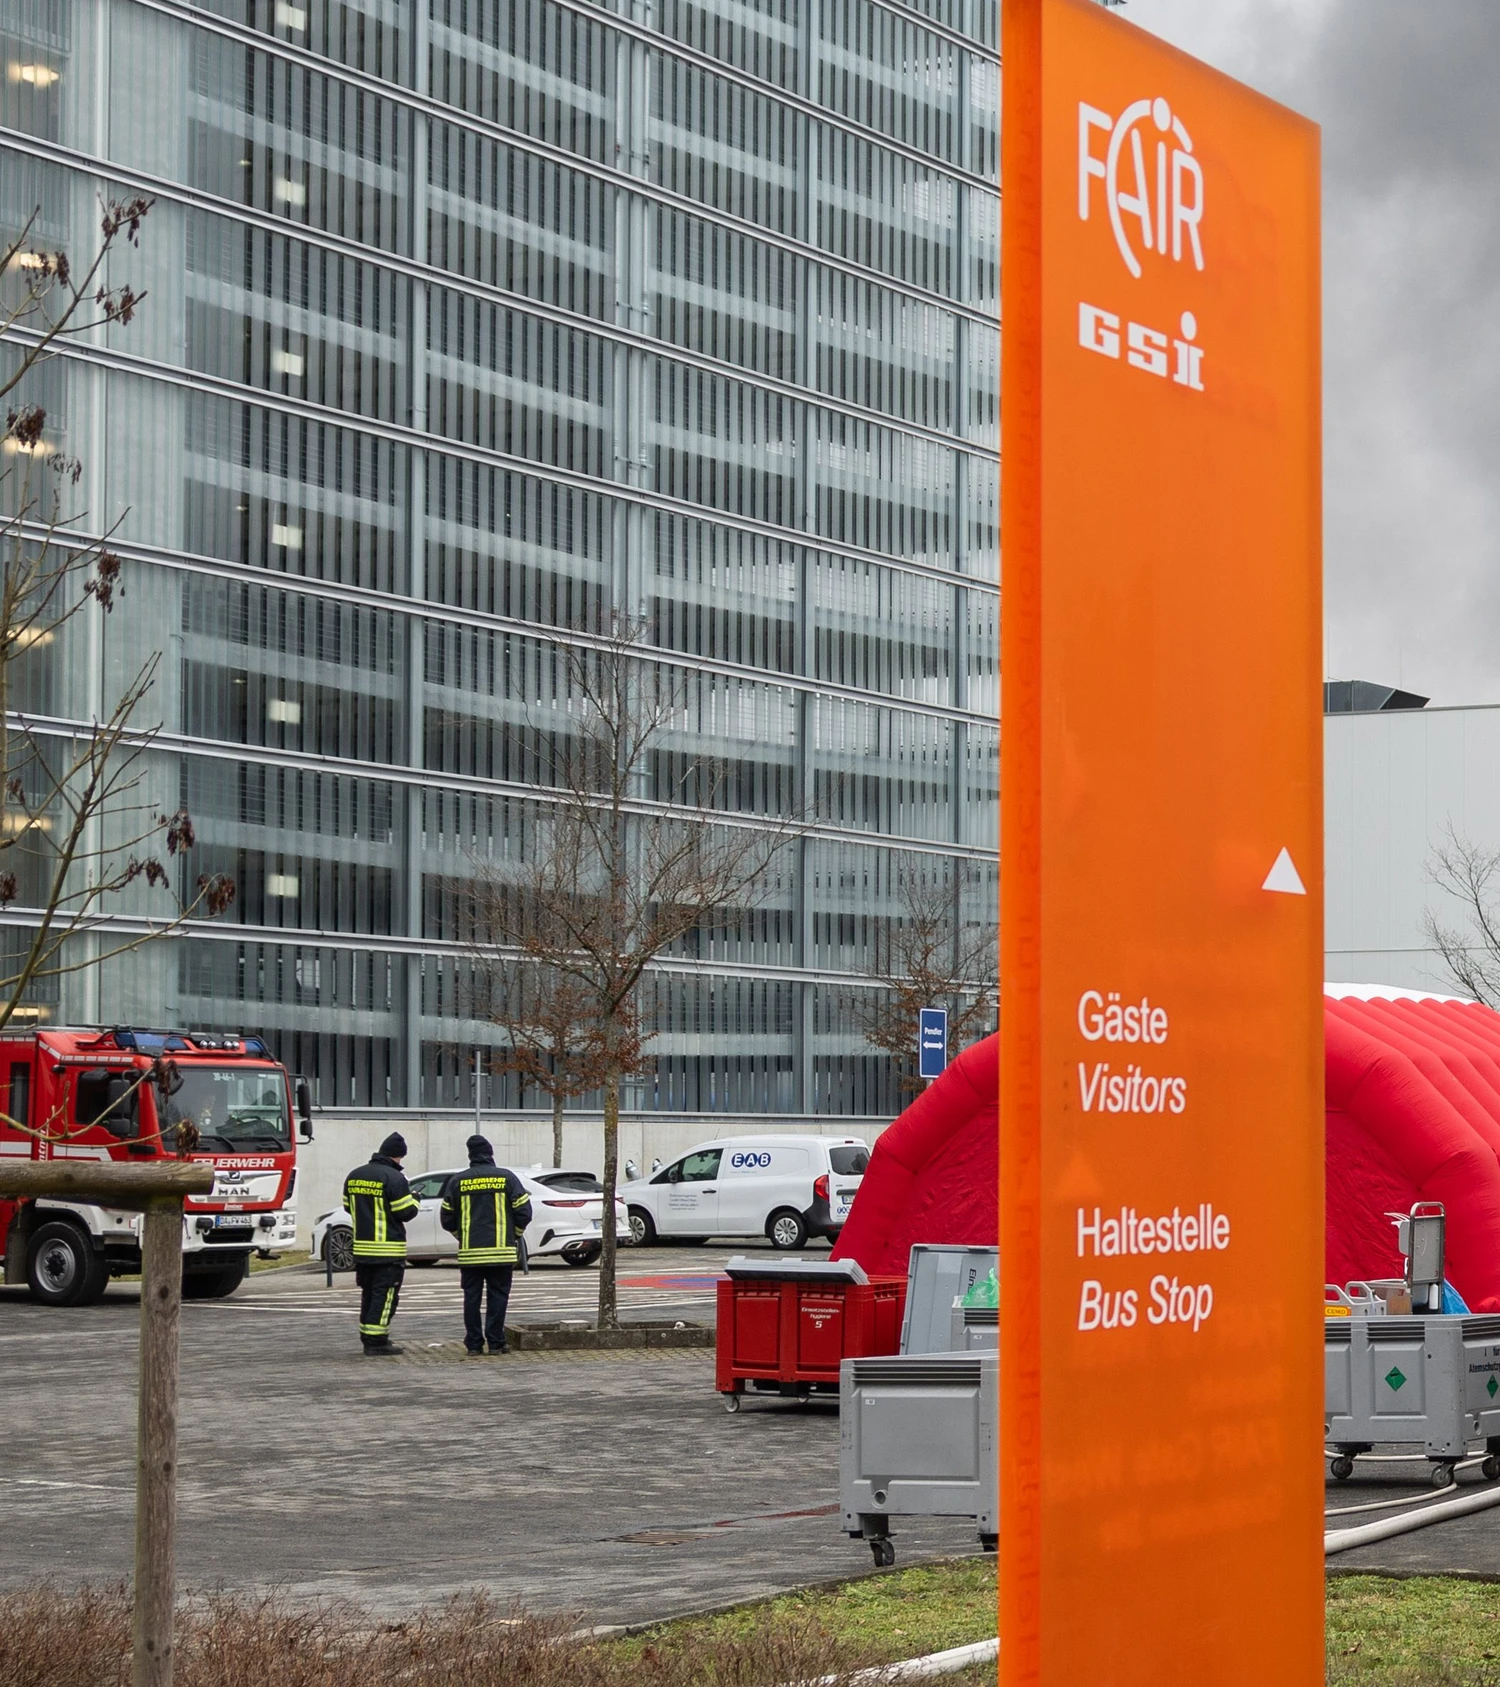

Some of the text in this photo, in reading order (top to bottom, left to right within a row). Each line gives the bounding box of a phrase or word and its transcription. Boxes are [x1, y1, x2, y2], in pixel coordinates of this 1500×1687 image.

[1078, 97, 1204, 278] FAIR
[1078, 302, 1204, 391] GSI
[924, 1027, 943, 1036] Pendler
[1077, 990, 1168, 1044] Gäste
[1077, 1062, 1187, 1113] Visitors
[460, 1177, 506, 1186] FEUERWEHR
[732, 1153, 771, 1167] EAB
[218, 1187, 250, 1196] MAN
[460, 1183, 506, 1192] DARMSTADT
[1077, 1203, 1230, 1257] Haltestelle
[1077, 1279, 1139, 1331] Bus
[1146, 1274, 1213, 1333] Stop
